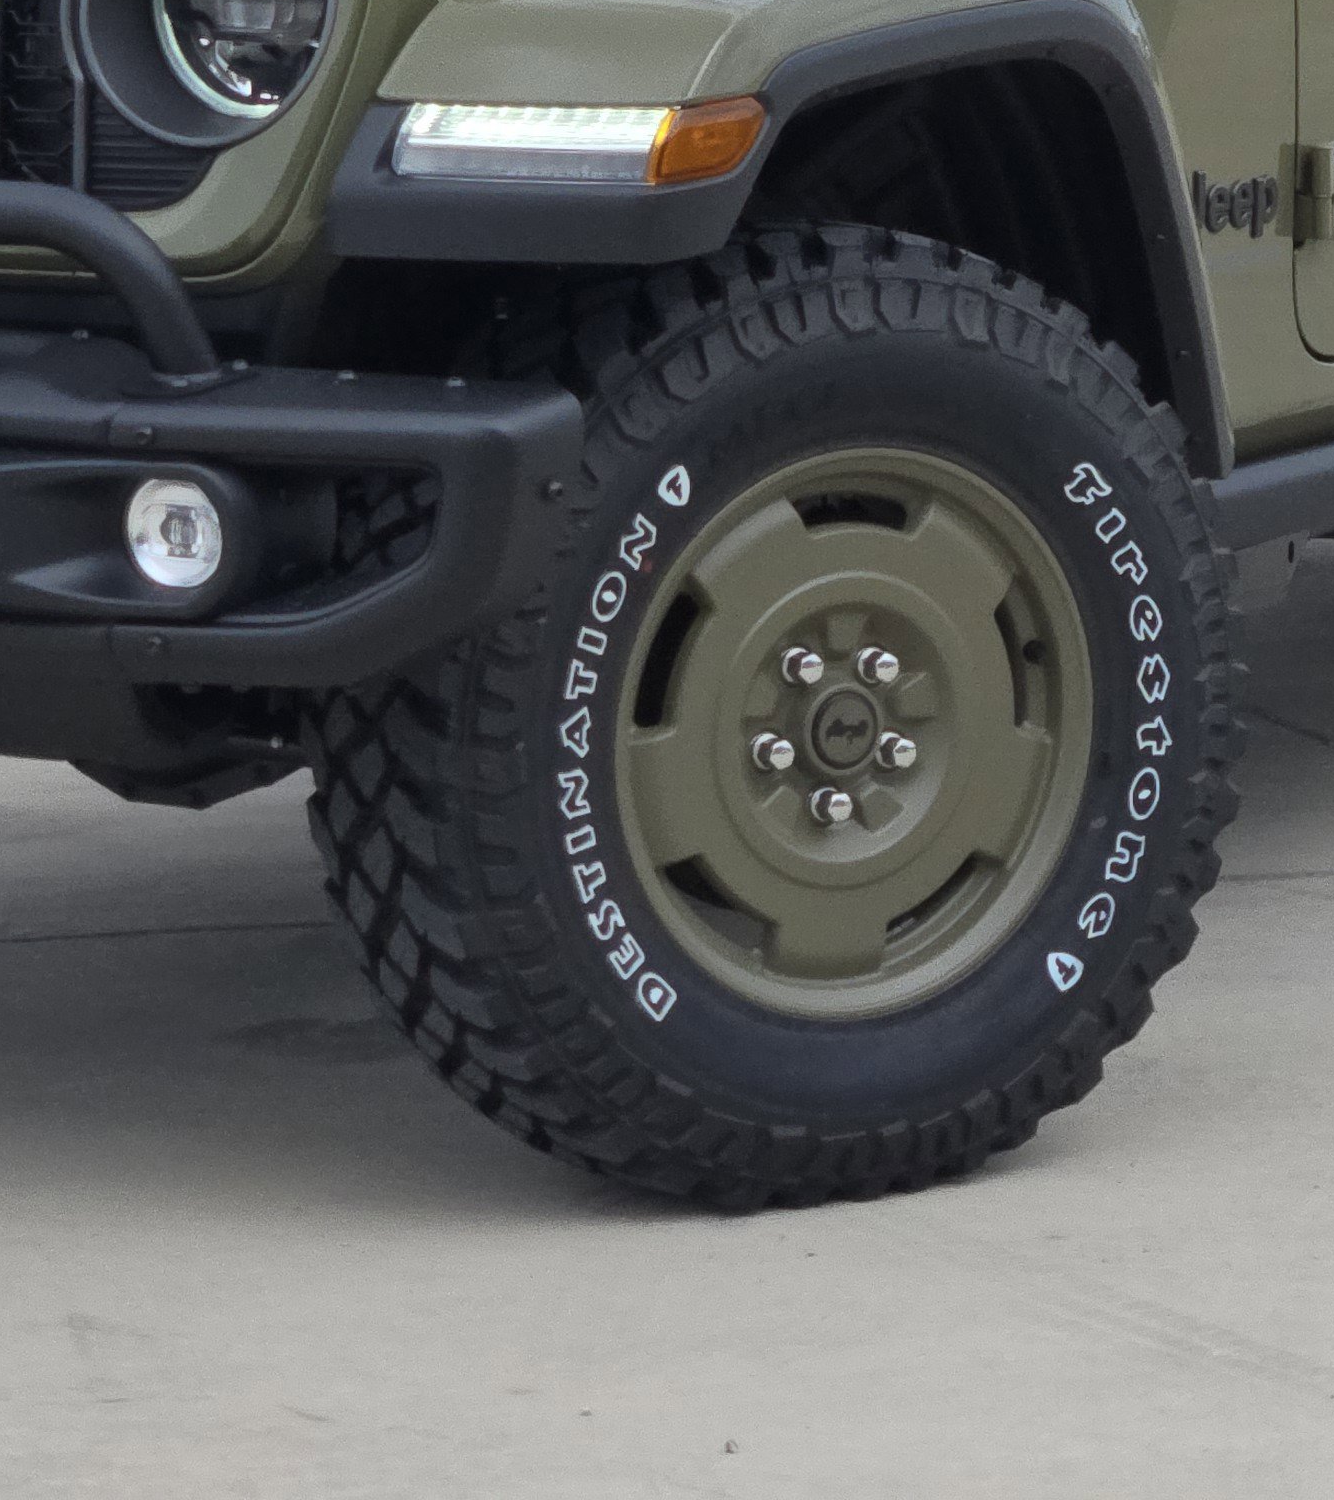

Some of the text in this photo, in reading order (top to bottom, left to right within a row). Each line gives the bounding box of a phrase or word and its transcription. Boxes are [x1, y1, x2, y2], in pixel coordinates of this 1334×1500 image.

[1192, 170, 1279, 240] Jeep
[559, 513, 676, 1021] DESTINATION
[1064, 462, 1172, 938] Firestone
